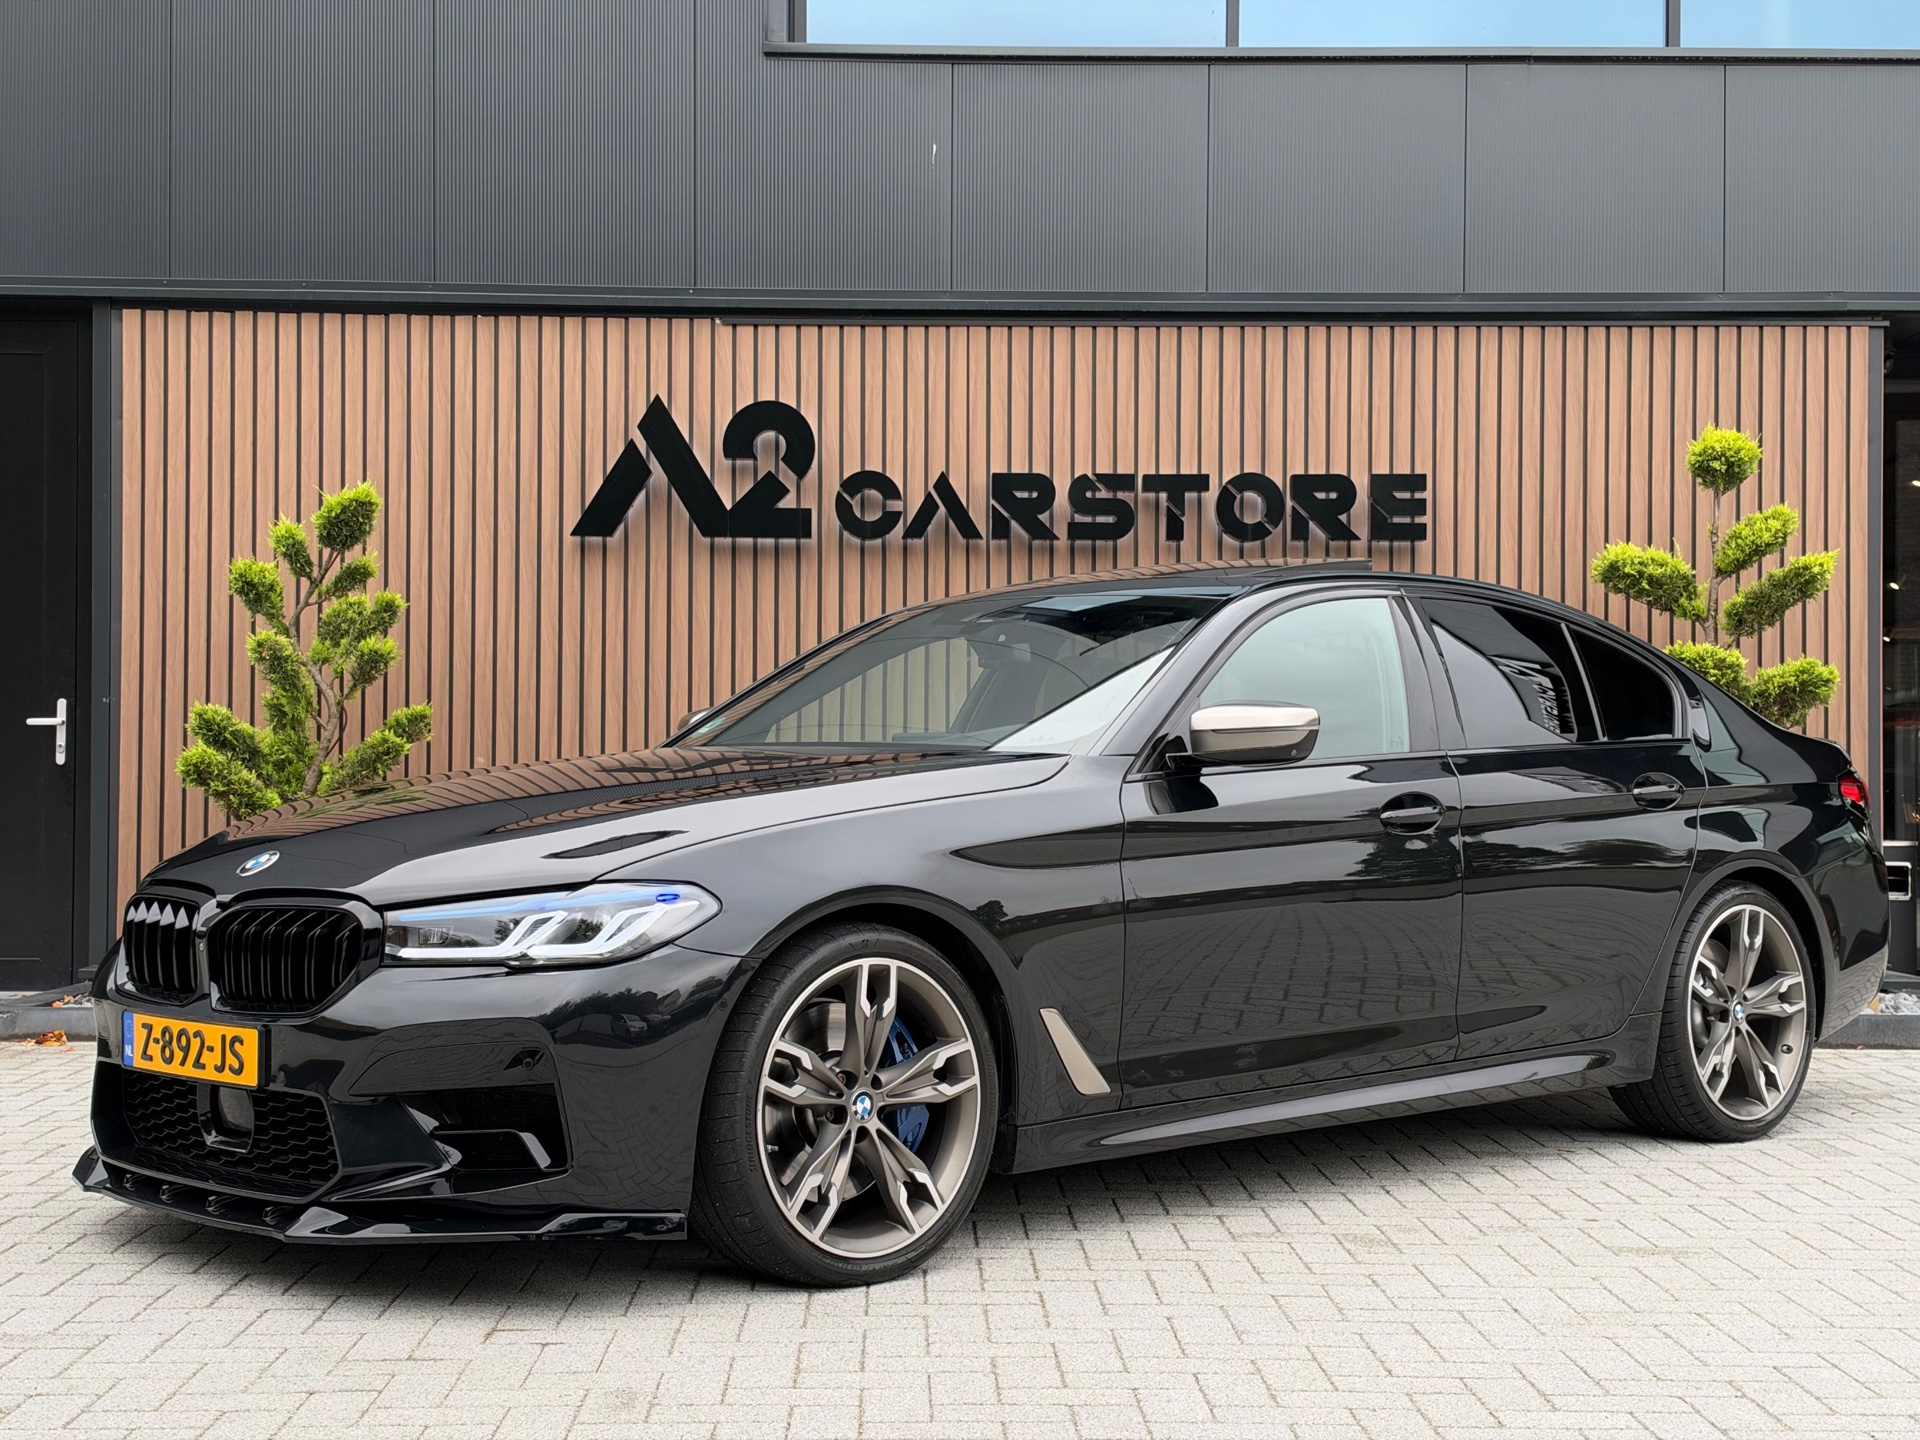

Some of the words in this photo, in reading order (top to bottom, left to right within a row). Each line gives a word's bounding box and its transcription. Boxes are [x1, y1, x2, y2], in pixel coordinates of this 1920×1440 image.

[570, 393, 815, 538] A2
[835, 470, 1427, 542] CARSTORE
[125, 1044, 134, 1057] NL
[140, 1022, 244, 1076] Z-892-JS
[744, 1092, 758, 1173] BRIDGESTONE
